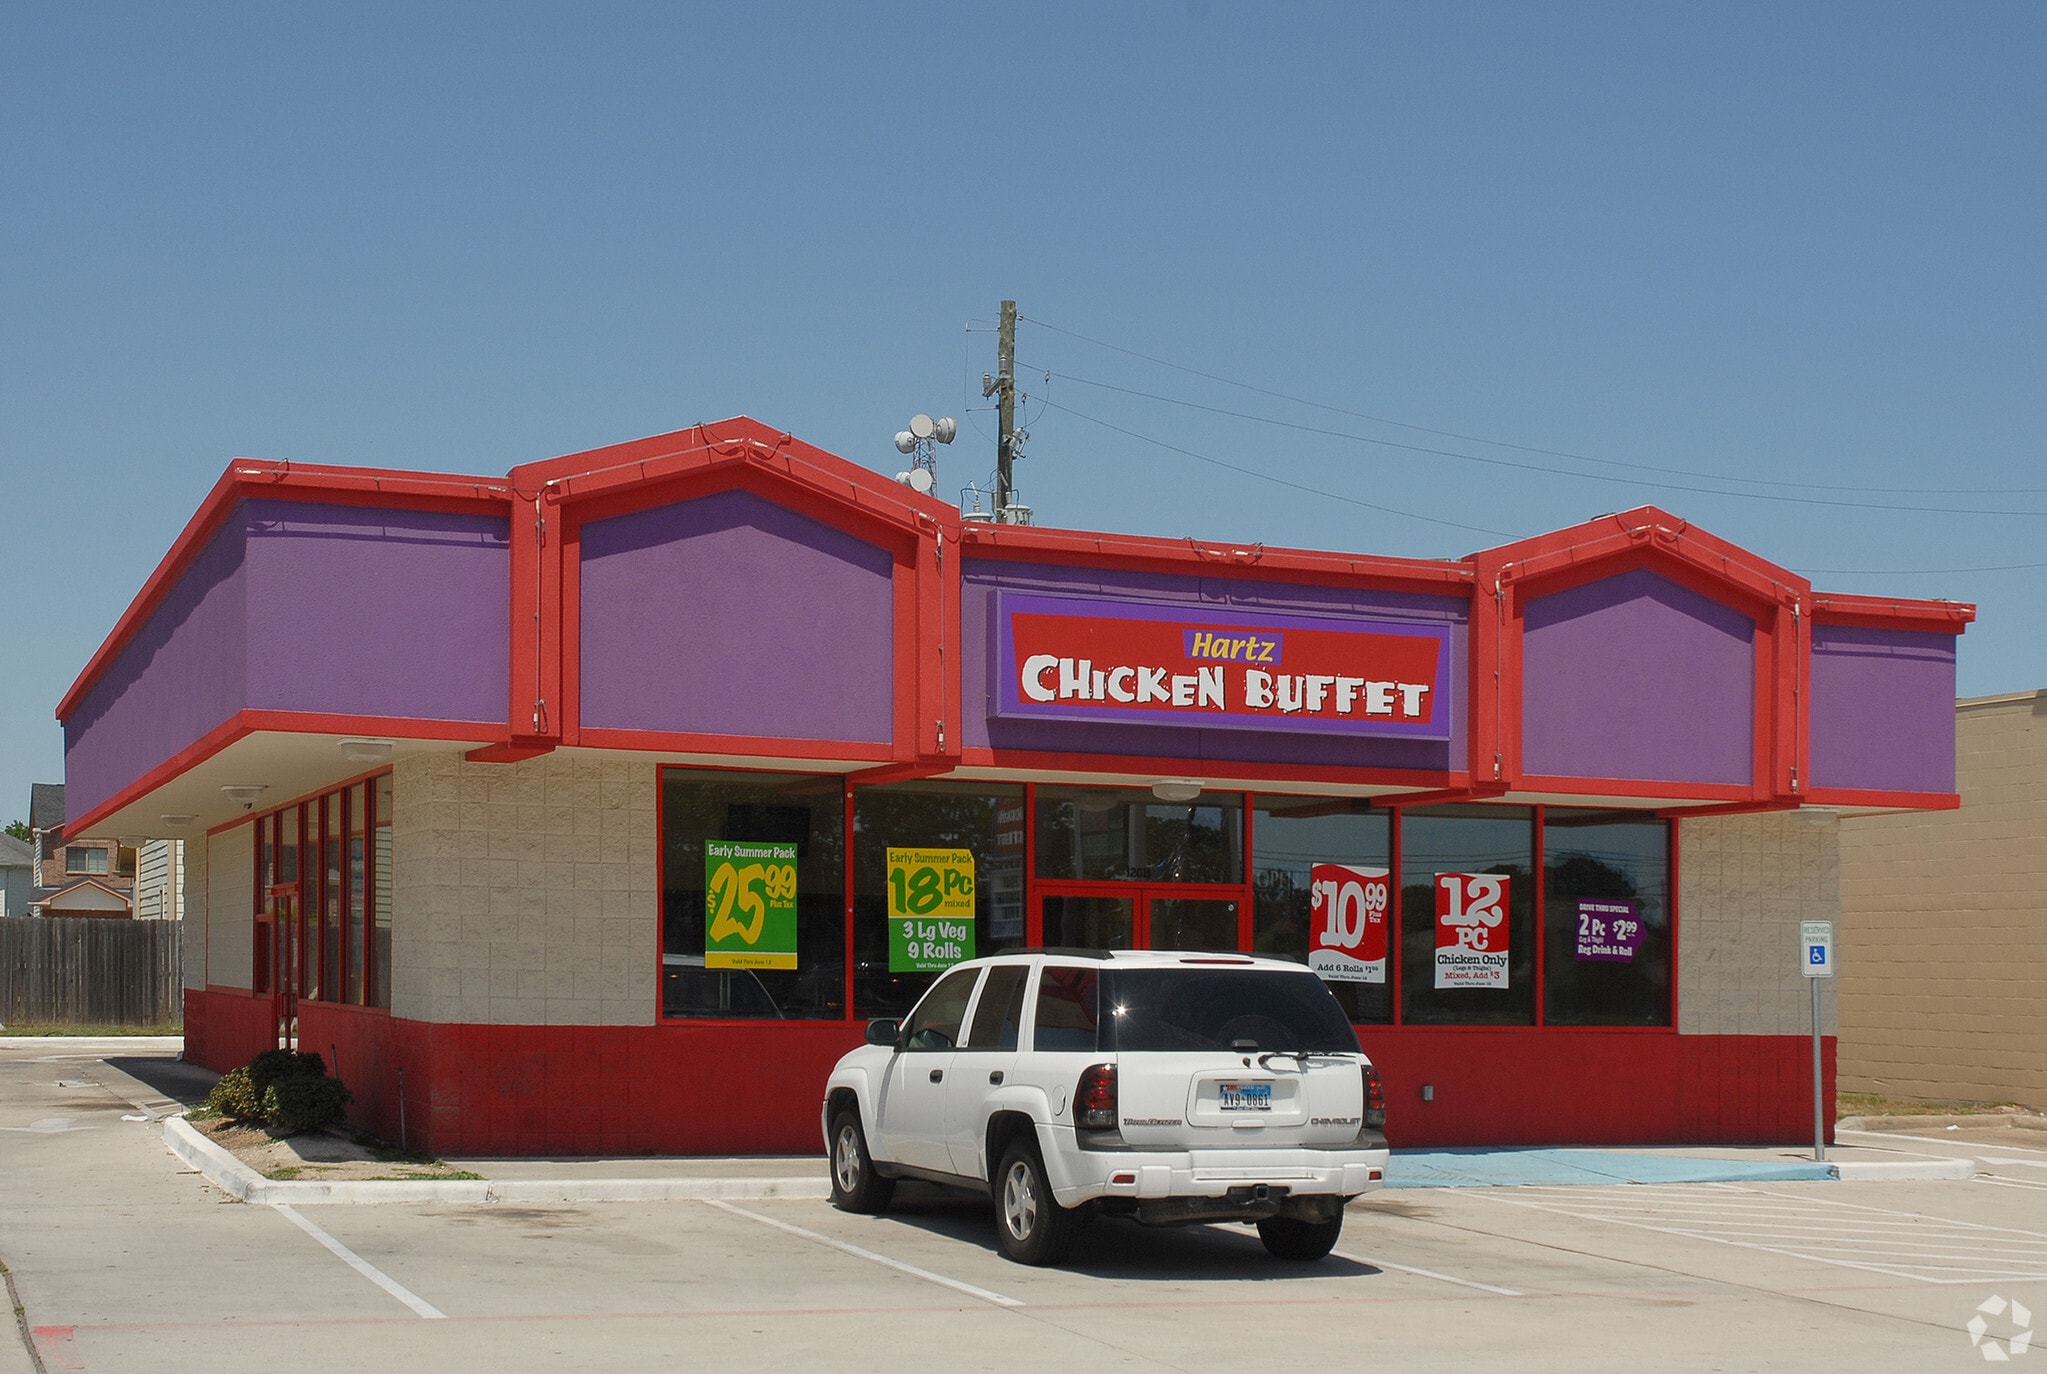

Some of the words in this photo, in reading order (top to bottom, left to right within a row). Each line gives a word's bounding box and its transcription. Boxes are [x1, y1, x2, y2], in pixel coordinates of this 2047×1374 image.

[1191, 632, 1275, 662] Hartz
[1021, 654, 1226, 711] CHICKEN
[1244, 668, 1429, 717] BUFFET
[708, 843, 733, 859] Early
[734, 845, 772, 858] Summer
[773, 847, 795, 859] Pack
[889, 852, 913, 865] Early
[914, 852, 950, 863] Summer
[952, 853, 973, 864] Pack
[889, 866, 944, 915] 18
[782, 900, 794, 908] Tax
[944, 899, 971, 908] mixed
[1440, 876, 1504, 928] 12
[1595, 904, 1609, 912] THRU
[902, 921, 914, 939] 3
[917, 921, 936, 941] Lg
[938, 921, 967, 941] Veg
[1579, 913, 1589, 935] 2
[1455, 927, 1489, 950] PC
[907, 941, 919, 959] 9
[923, 941, 962, 959] Rolls
[1578, 944, 1592, 956] Reg
[1592, 945, 1611, 954] Drink
[1612, 945, 1618, 955] &
[1619, 946, 1633, 956] Roll
[1317, 963, 1334, 971] Add
[1335, 964, 1342, 972] 6
[1343, 964, 1364, 973] Rolls
[1437, 954, 1480, 965] Chicken
[1482, 954, 1507, 967] Only
[1444, 972, 1472, 980] Mixed,
